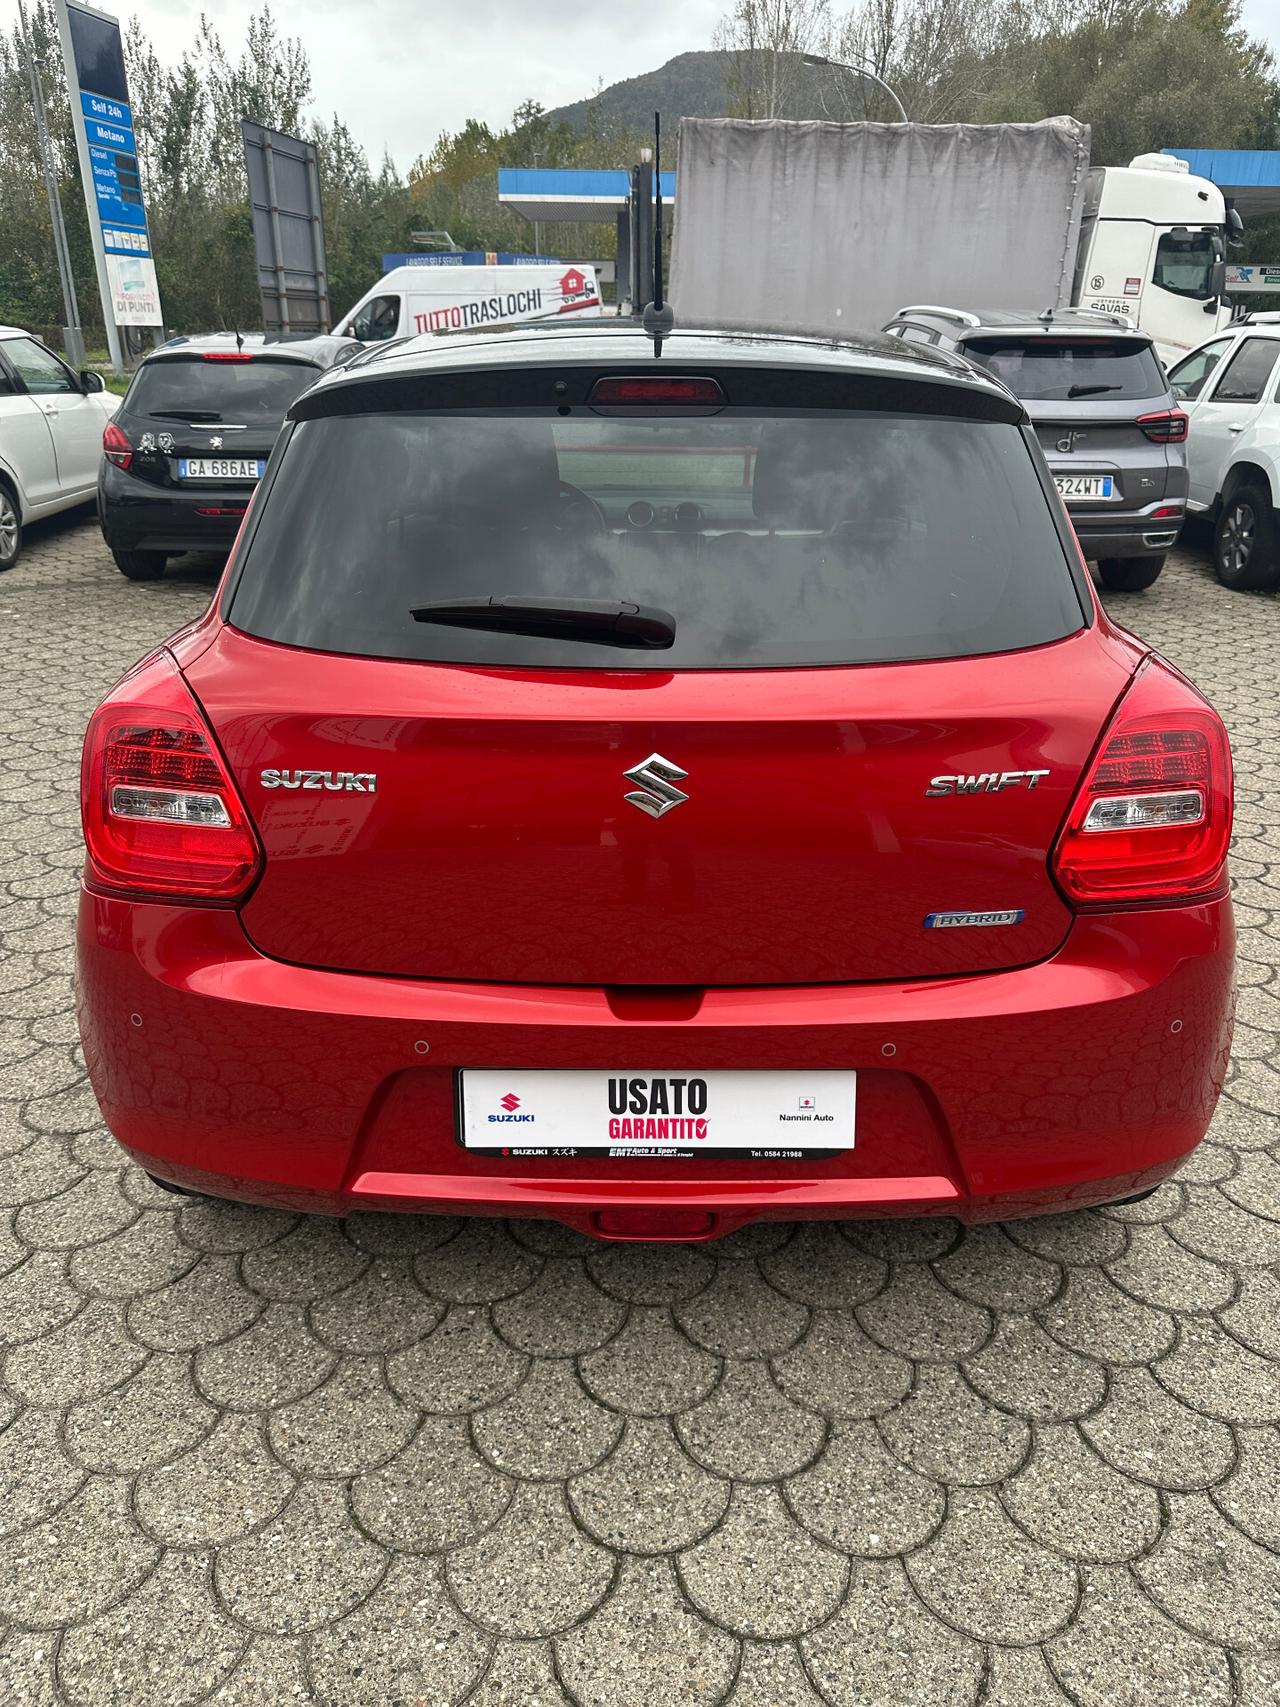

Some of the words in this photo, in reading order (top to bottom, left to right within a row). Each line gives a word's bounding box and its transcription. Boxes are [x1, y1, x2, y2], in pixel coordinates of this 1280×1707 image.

[91, 99, 107, 115] Self
[107, 104, 123, 119] 24h
[96, 126, 125, 144] Metano
[117, 300, 127, 312] DI
[260, 769, 377, 793] SUZUKI
[925, 769, 1050, 797] SWIFT
[940, 912, 1011, 926] HYBRID
[608, 1078, 708, 1115] USATO
[487, 1114, 535, 1123] SUZUKI
[779, 1113, 812, 1122] Nannini
[813, 1113, 834, 1122] Auto
[608, 1117, 711, 1140] GARANTITO
[512, 1148, 548, 1156] SUZUKI
[552, 1148, 578, 1156] スズキ
[609, 1147, 632, 1157] EMT
[657, 1147, 678, 1156] Sport
